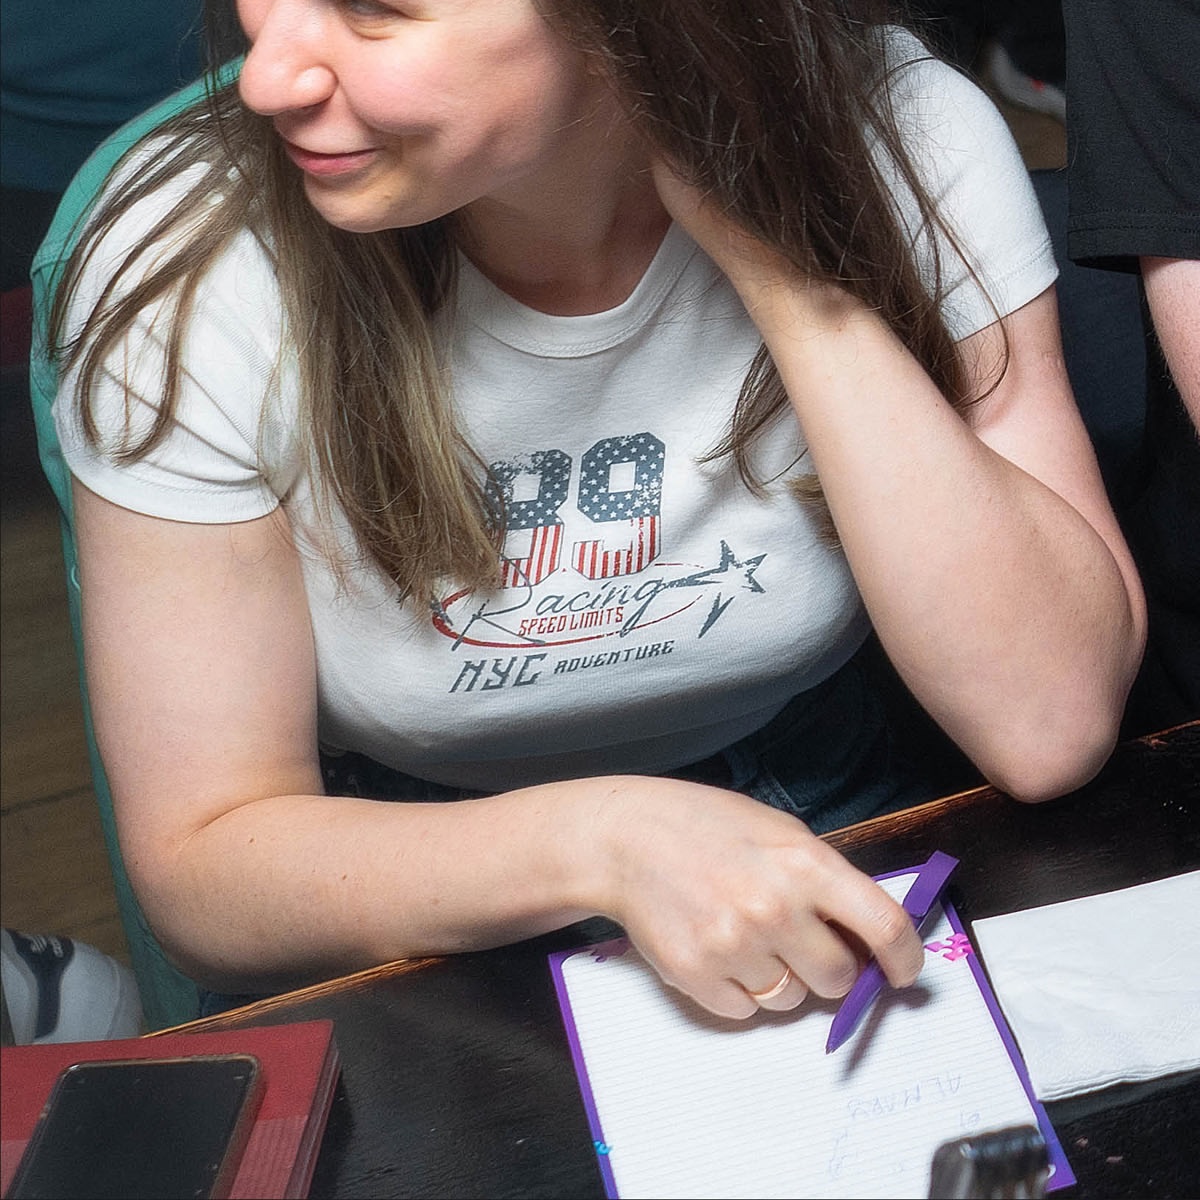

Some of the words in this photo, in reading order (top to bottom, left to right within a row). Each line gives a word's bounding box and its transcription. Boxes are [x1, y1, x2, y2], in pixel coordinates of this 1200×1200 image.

[518, 614, 567, 637] SPEED
[569, 606, 625, 631] LIMITS
[449, 653, 548, 693] NYC
[553, 640, 675, 675] ADVENTURE
